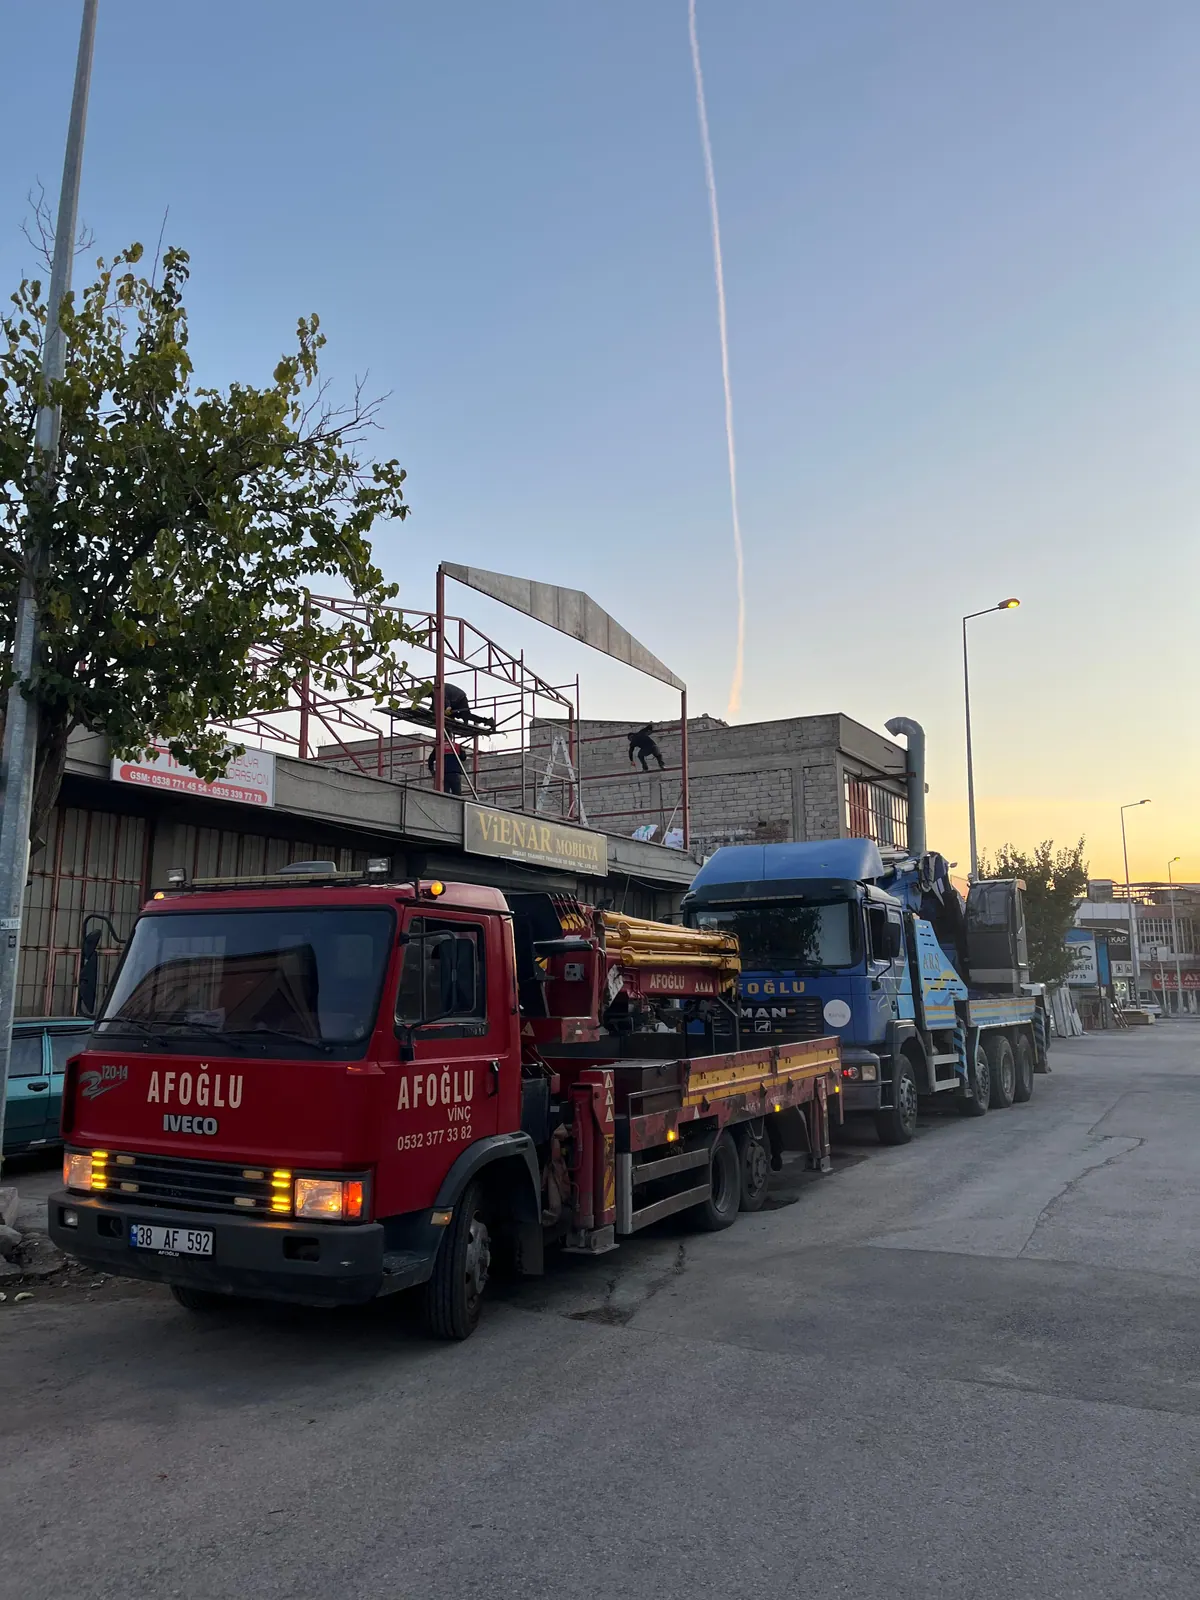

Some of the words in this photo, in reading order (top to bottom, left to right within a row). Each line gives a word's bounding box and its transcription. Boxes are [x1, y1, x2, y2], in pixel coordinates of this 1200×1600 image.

[130, 771, 150, 782] GSM:
[172, 778, 185, 789] 771
[187, 781, 196, 791] 45
[198, 784, 207, 793] 54
[212, 786, 229, 797] 0535
[244, 792, 252, 801] 77
[650, 972, 685, 990] AFOĞLU
[741, 1007, 787, 1018] MAN
[147, 1064, 244, 1108] AFOĞLU
[397, 1065, 474, 1111] AFOĞLU
[163, 1114, 218, 1135] IVECO
[447, 1104, 471, 1122] VİNÇ
[397, 1133, 423, 1151] 0532
[426, 1129, 444, 1146] 377
[447, 1127, 458, 1142] 33
[461, 1125, 472, 1140] 82
[138, 1227, 152, 1246] 38
[164, 1230, 179, 1249] AF
[187, 1231, 210, 1253] 592
